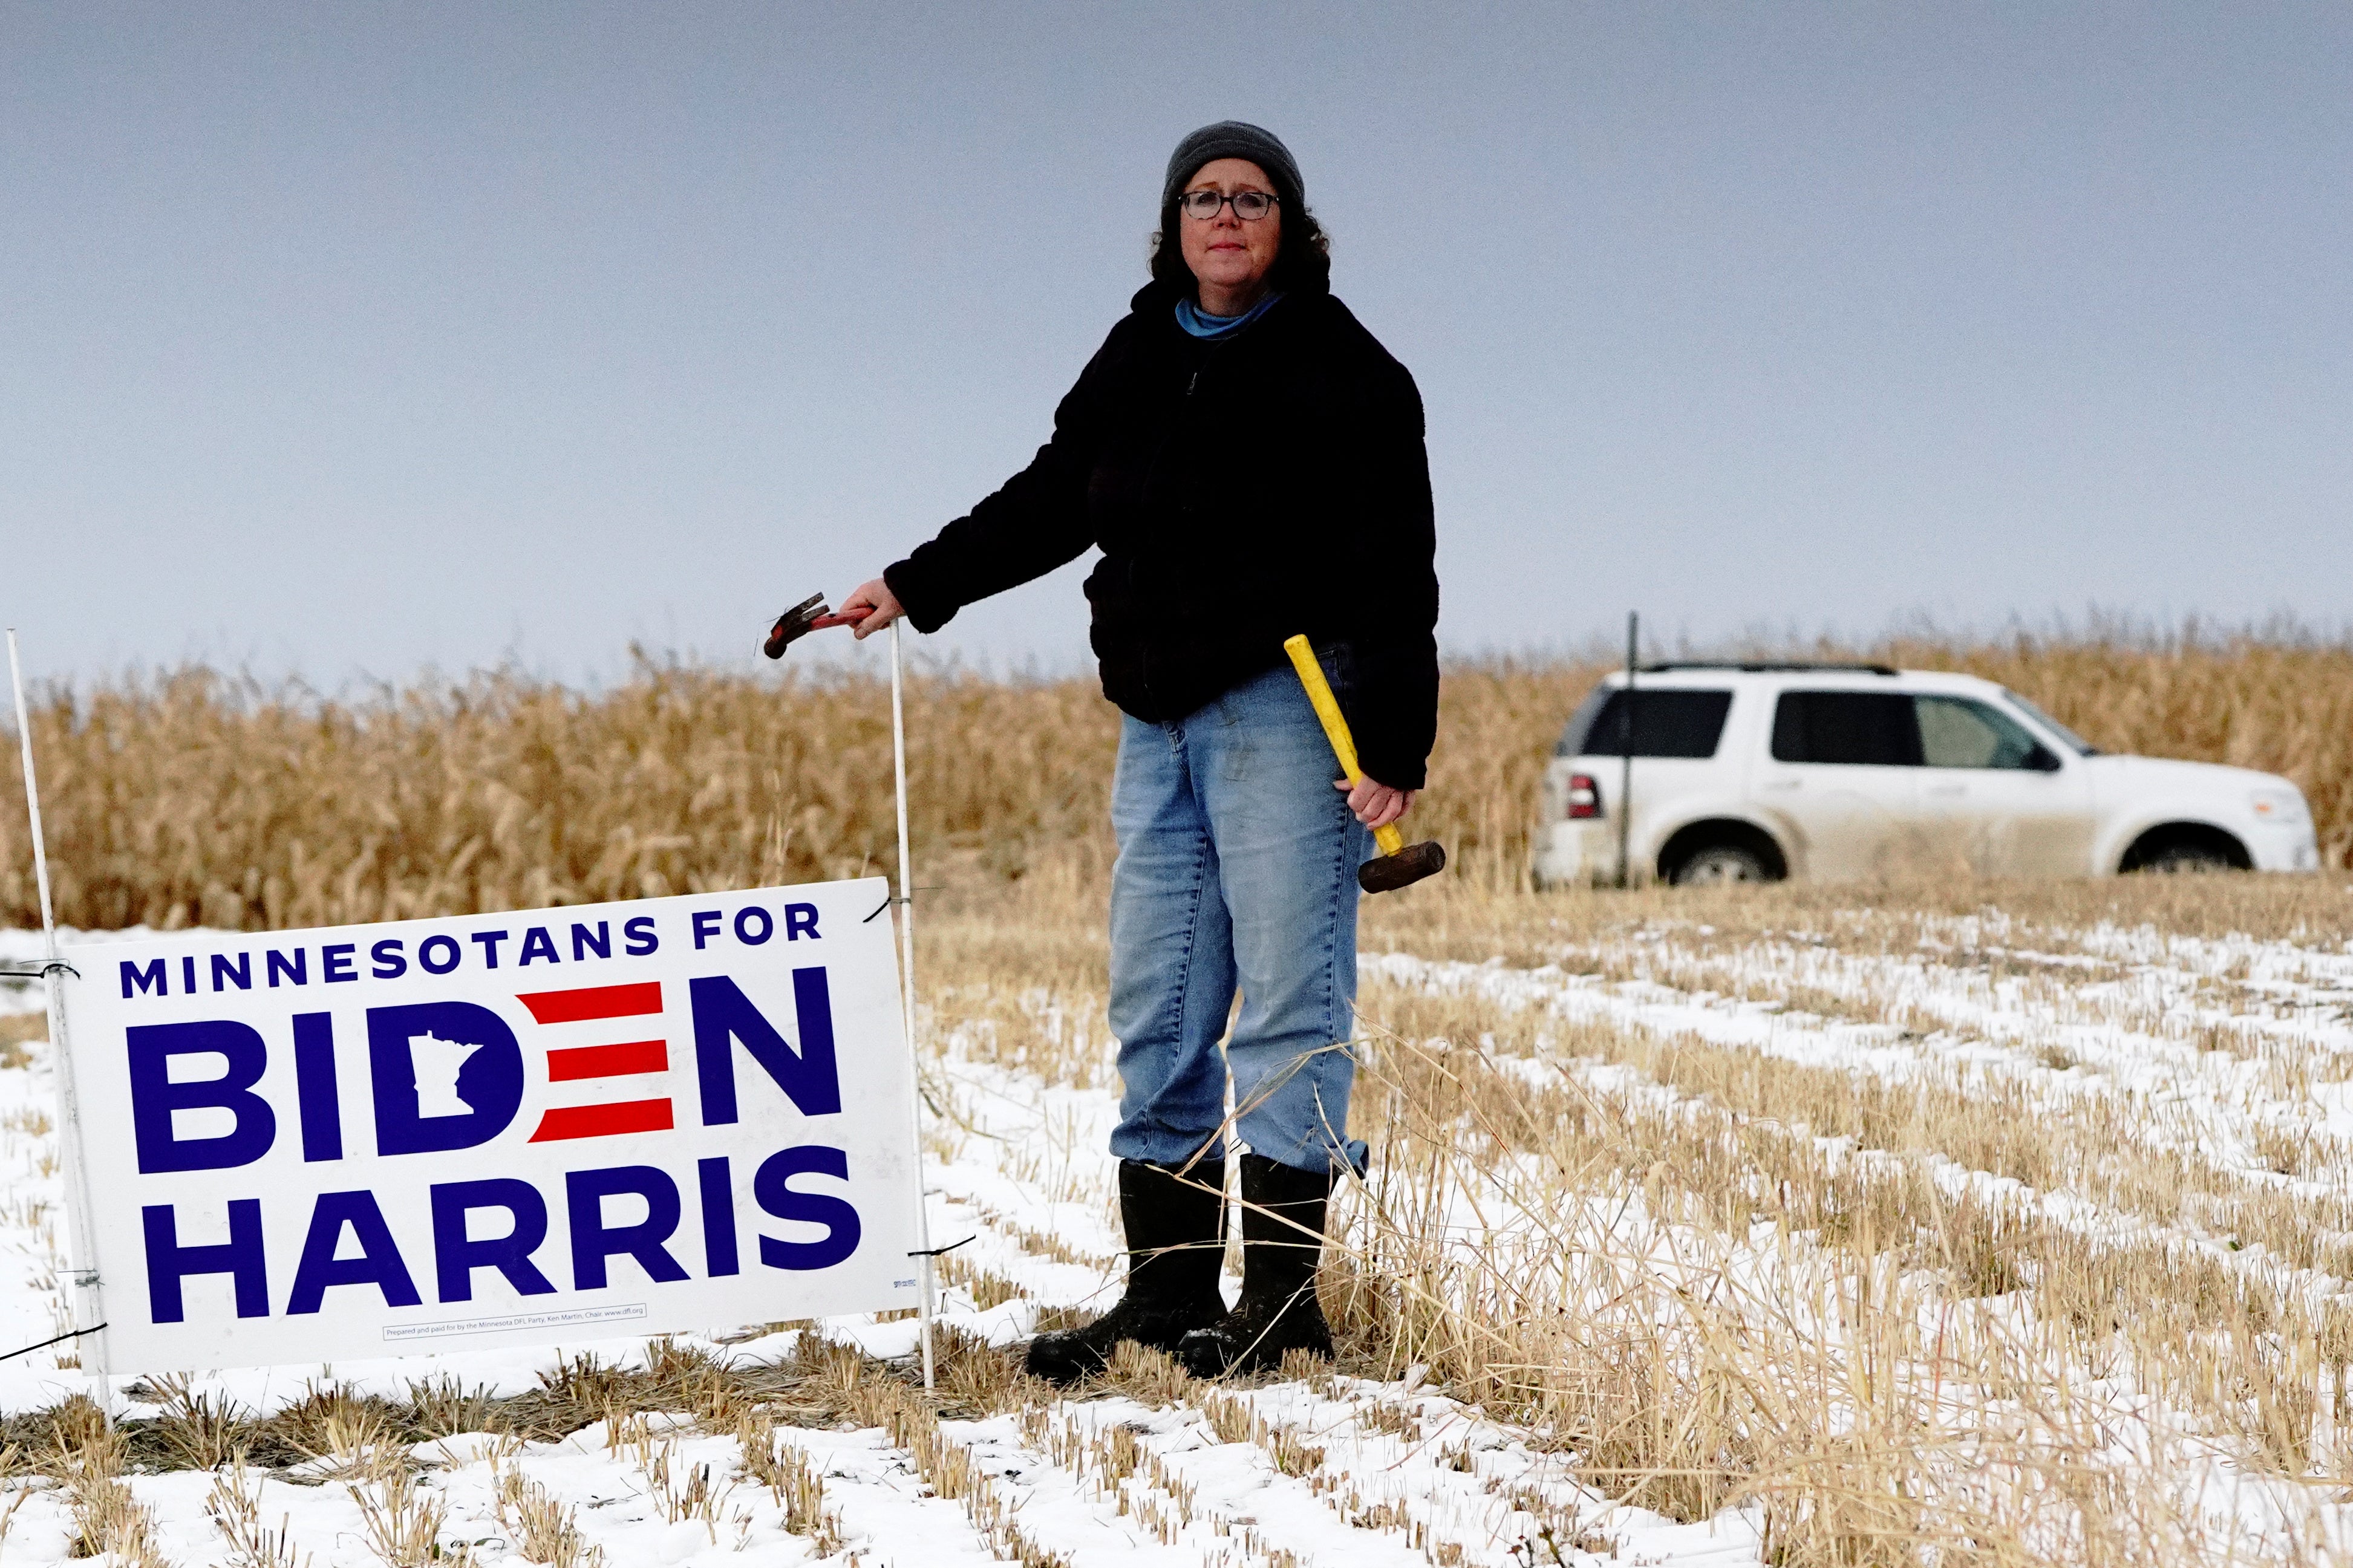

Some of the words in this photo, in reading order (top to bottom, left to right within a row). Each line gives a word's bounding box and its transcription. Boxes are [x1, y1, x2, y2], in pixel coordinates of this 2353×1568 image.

[120, 916, 659, 999] MINNESOTANS
[691, 902, 821, 950] FOR
[126, 966, 841, 1174] BIDEN
[142, 1145, 861, 1324] HARRIS
[604, 1307, 644, 1316] www.dfl.org
